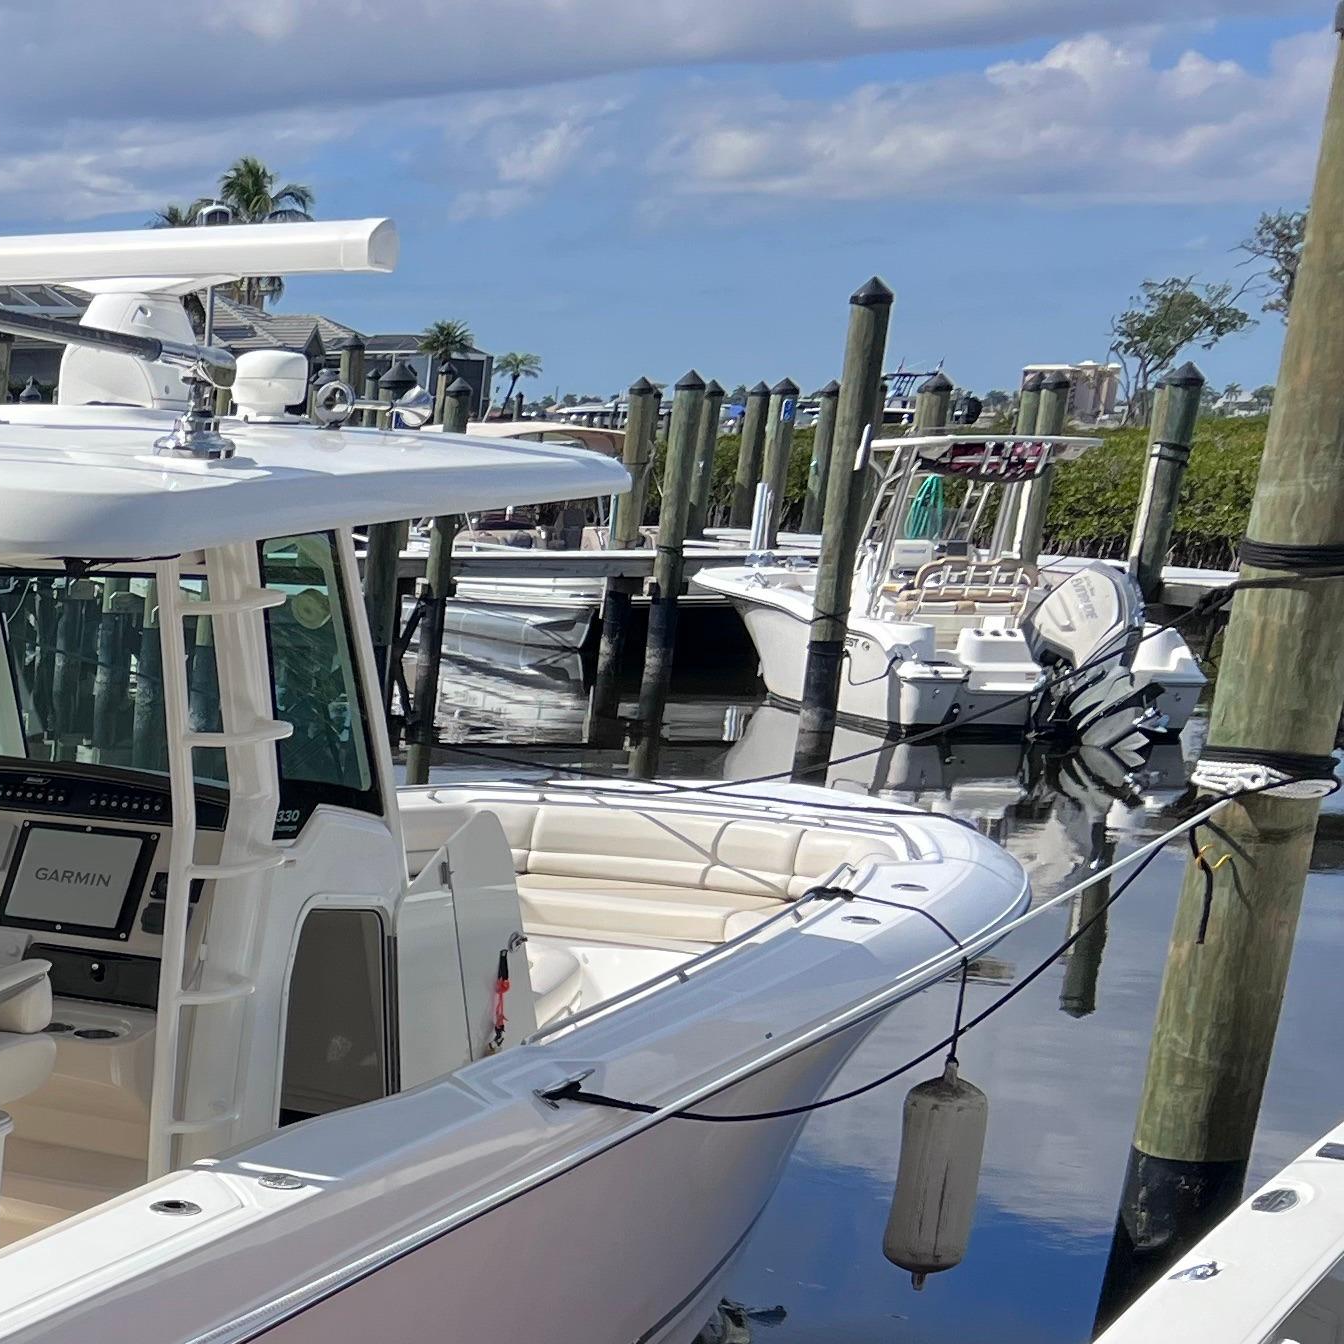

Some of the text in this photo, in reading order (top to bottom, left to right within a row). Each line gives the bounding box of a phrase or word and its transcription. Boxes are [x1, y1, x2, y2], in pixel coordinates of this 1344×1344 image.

[845, 636, 860, 649] EST
[276, 809, 300, 823] 330
[34, 867, 112, 888] GARMIN
